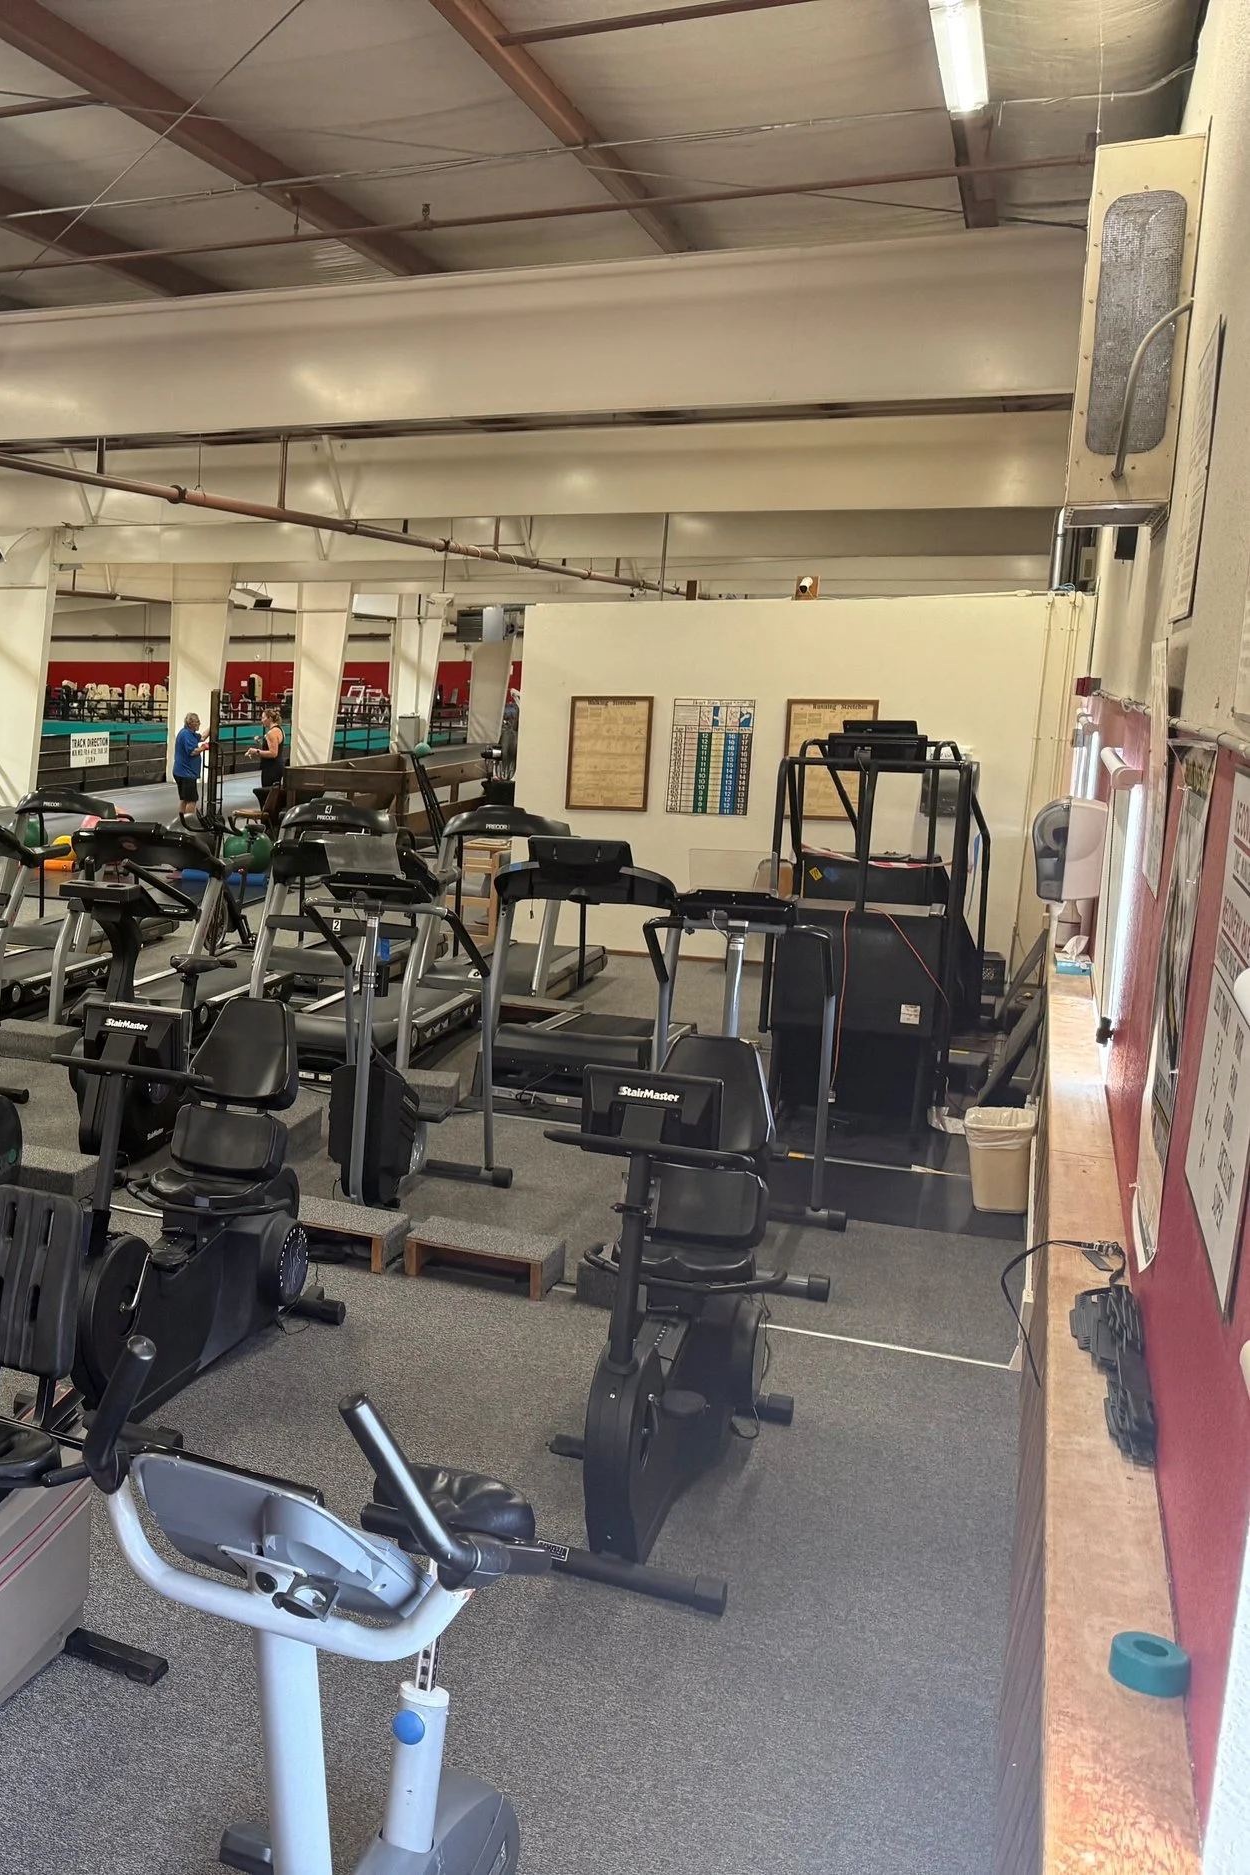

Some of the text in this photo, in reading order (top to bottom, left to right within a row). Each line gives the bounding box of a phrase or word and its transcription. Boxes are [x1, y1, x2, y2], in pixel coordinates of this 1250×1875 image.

[72, 736, 108, 748] TRACK DIRECTION
[334, 920, 339, 930] 2
[104, 1018, 148, 1031] StairMaster
[617, 1085, 680, 1102] StairMaster
